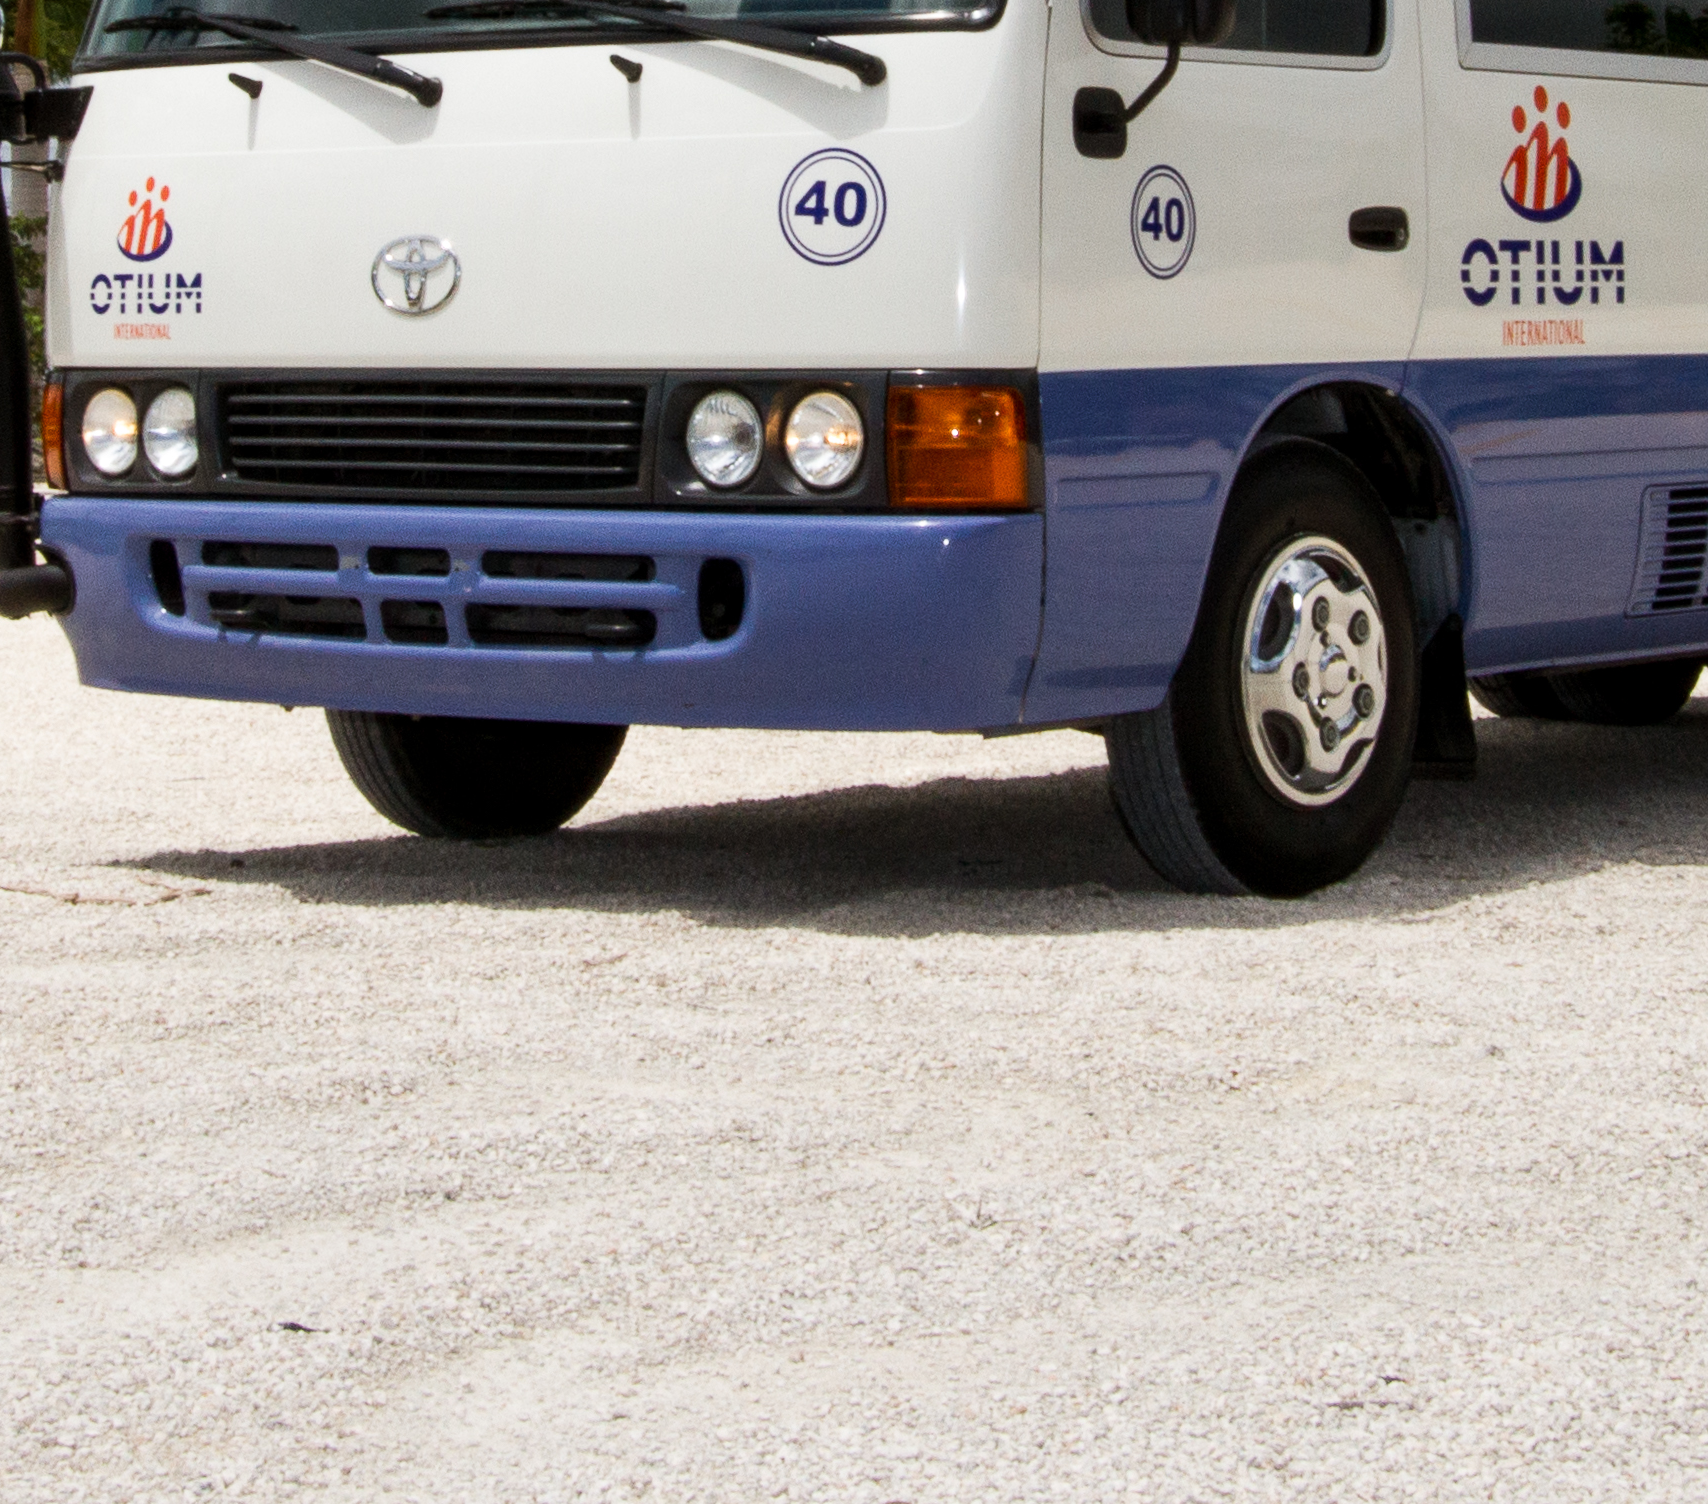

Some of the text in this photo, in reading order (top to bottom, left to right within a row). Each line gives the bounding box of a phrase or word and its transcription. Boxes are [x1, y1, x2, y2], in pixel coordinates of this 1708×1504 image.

[794, 180, 868, 228] 40
[1140, 196, 1185, 243] 40
[90, 273, 202, 315] OTIUM
[1460, 238, 1625, 307] OTIUM
[113, 323, 172, 340] INTERNATIONAL
[1502, 320, 1586, 346] INTERNATIONAL
